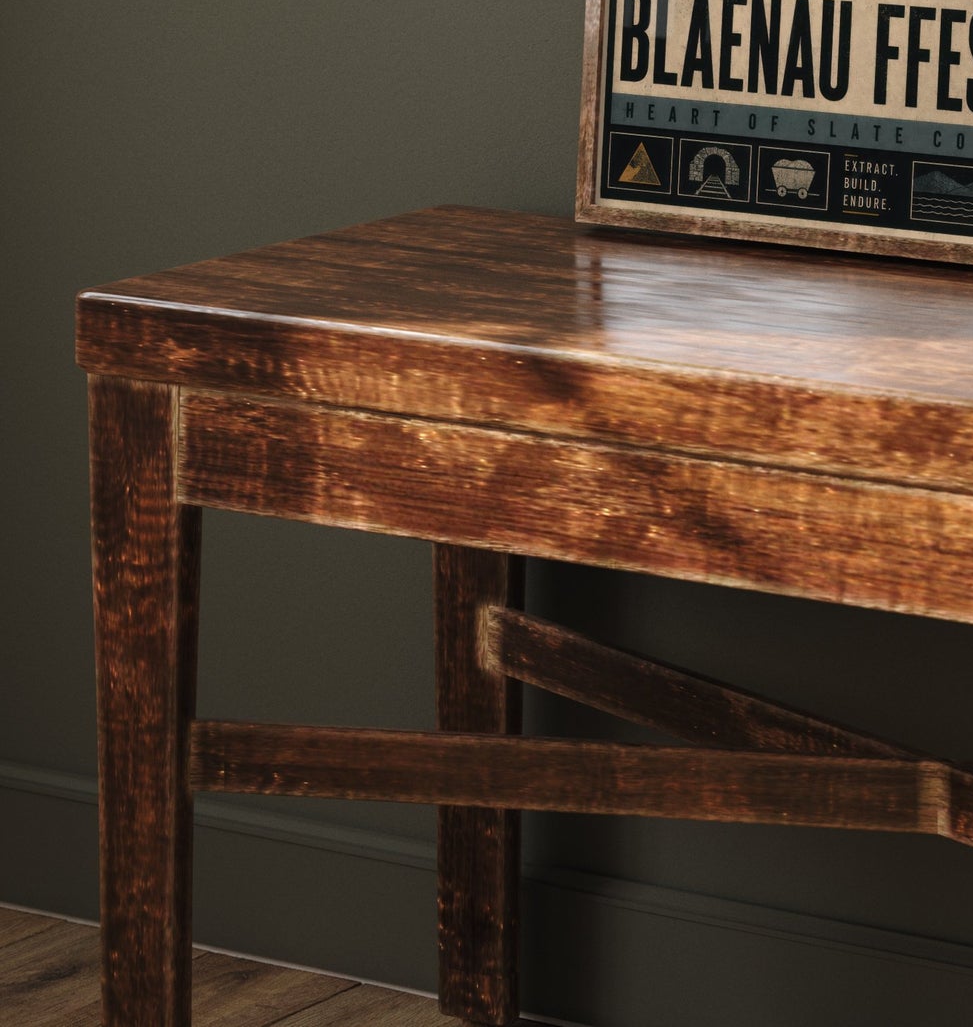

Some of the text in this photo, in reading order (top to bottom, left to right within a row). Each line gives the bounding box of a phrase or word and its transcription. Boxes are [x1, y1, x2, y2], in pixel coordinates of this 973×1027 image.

[625, 101, 721, 127] HEART
[748, 113, 779, 132] OF
[807, 118, 904, 144] SLATE
[844, 159, 899, 177] EXTRACT.
[843, 177, 881, 192] BUILD.
[843, 194, 891, 211] ENDURE.
